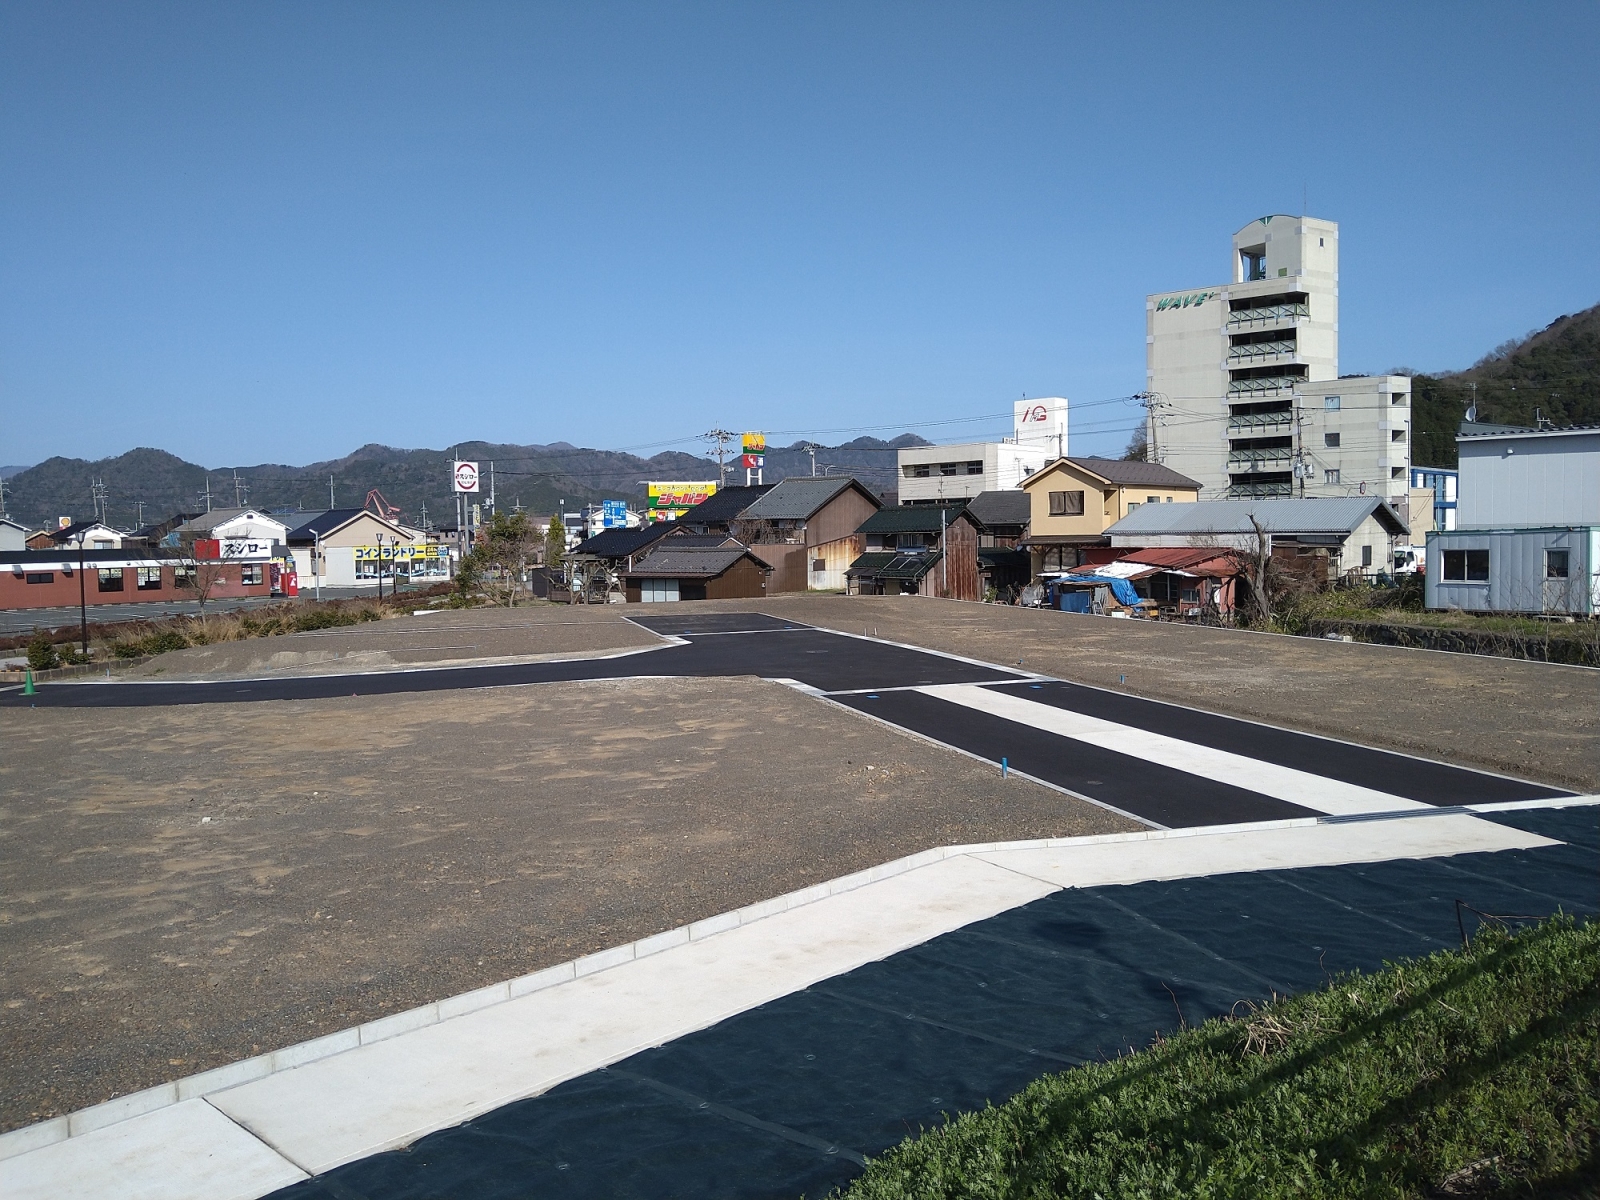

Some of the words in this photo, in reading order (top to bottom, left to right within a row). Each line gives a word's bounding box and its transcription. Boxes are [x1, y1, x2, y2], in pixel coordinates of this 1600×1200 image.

[657, 493, 708, 505] ジャパン
[224, 543, 268, 554] スシロー
[356, 547, 424, 558] コインランドリー
